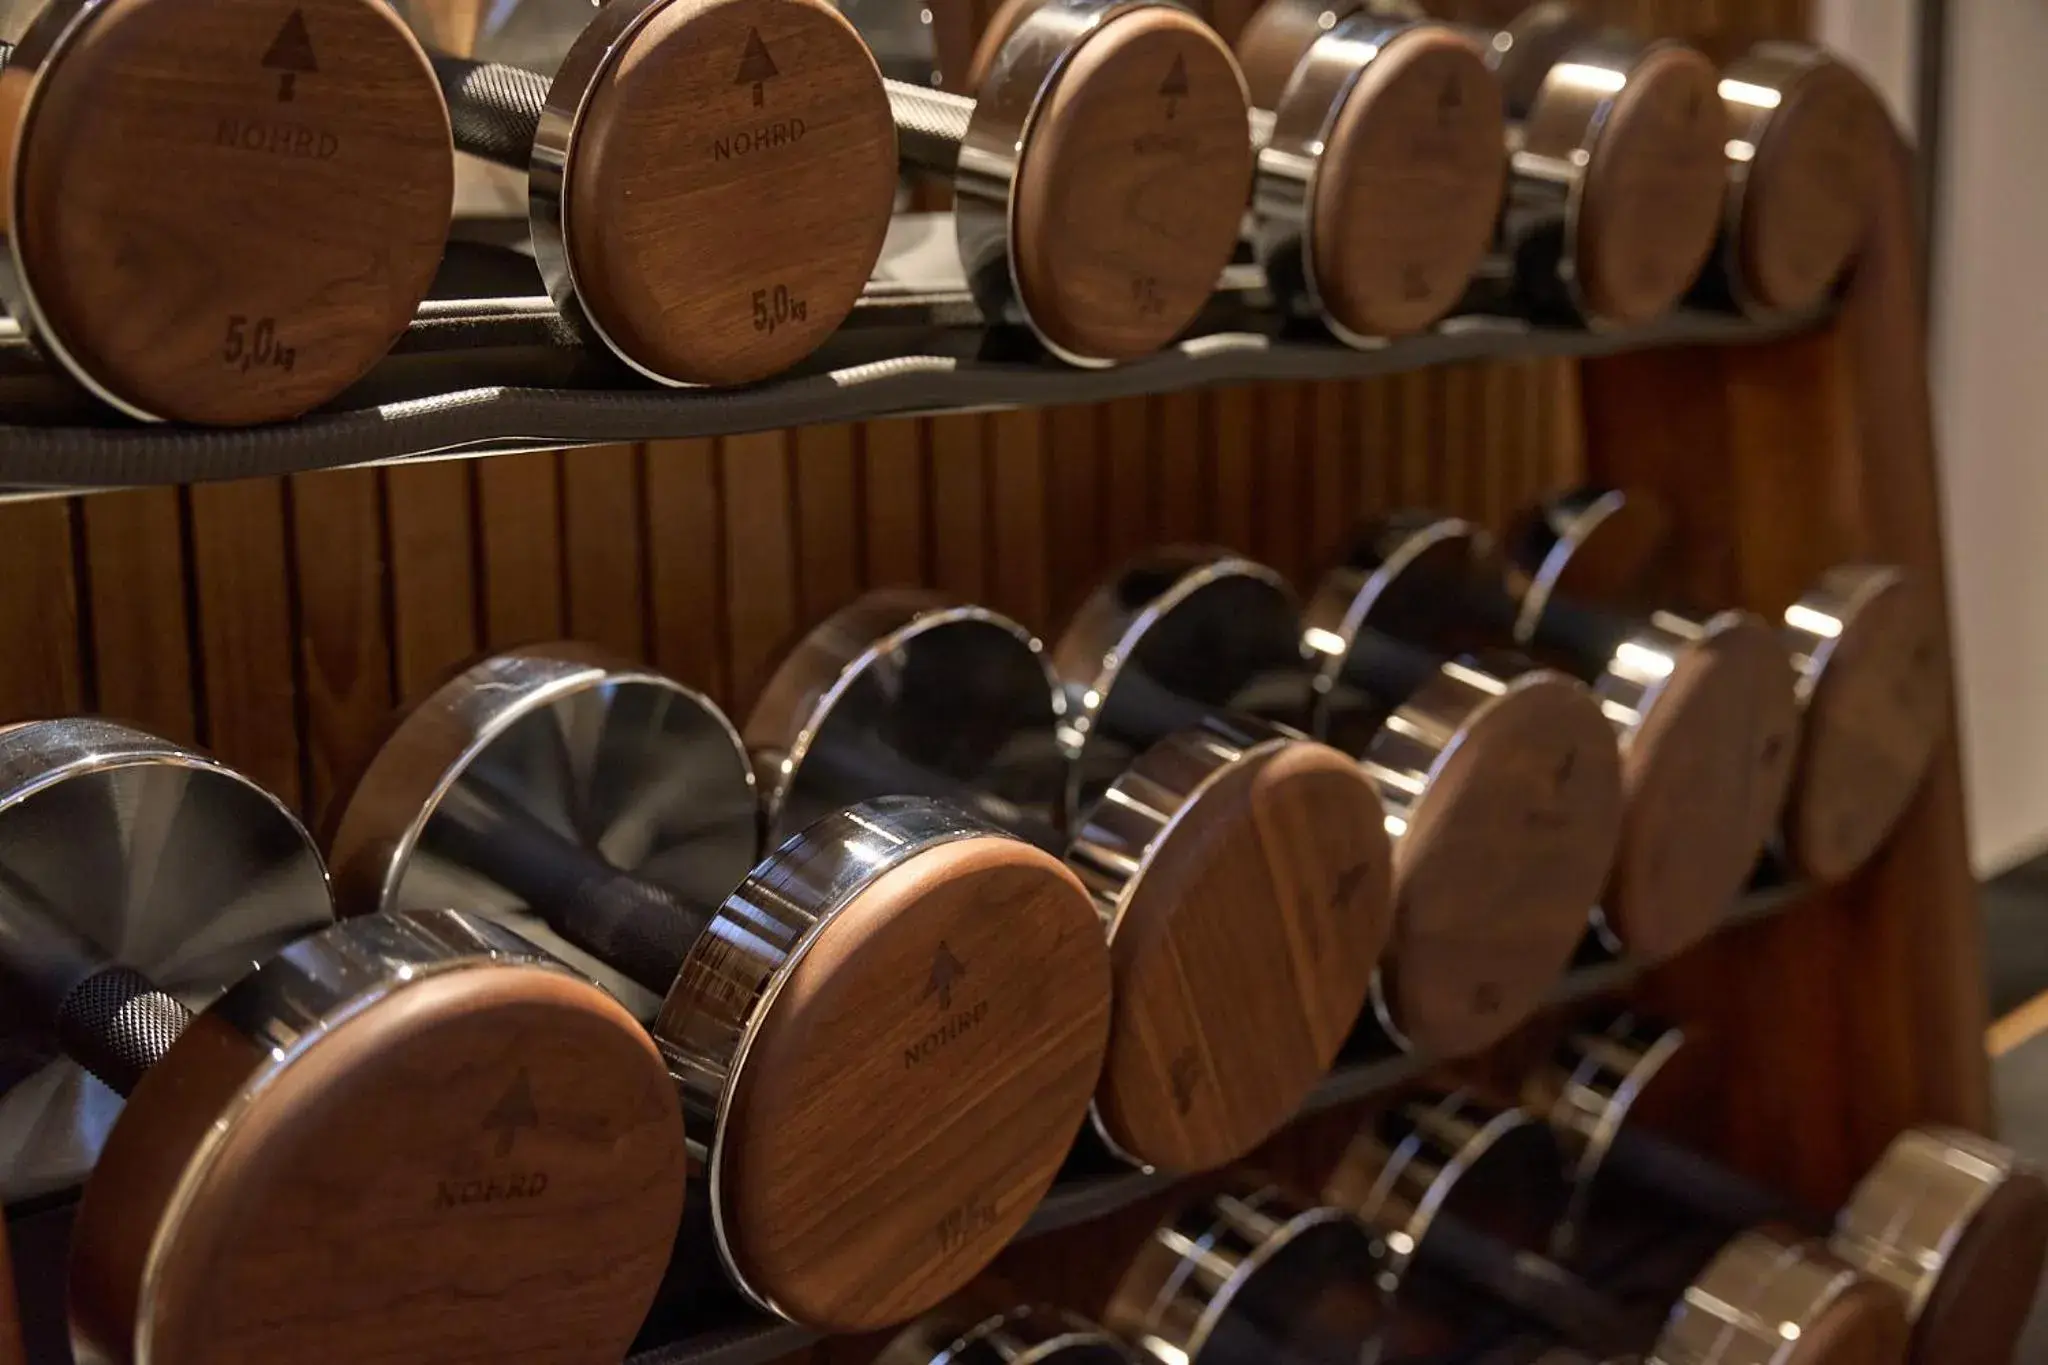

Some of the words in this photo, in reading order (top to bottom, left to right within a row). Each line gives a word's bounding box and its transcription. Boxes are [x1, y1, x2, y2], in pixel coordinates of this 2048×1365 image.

[217, 119, 339, 160] NOHRD
[714, 117, 806, 161] NOHRD
[434, 1171, 548, 1209] NOHRD
